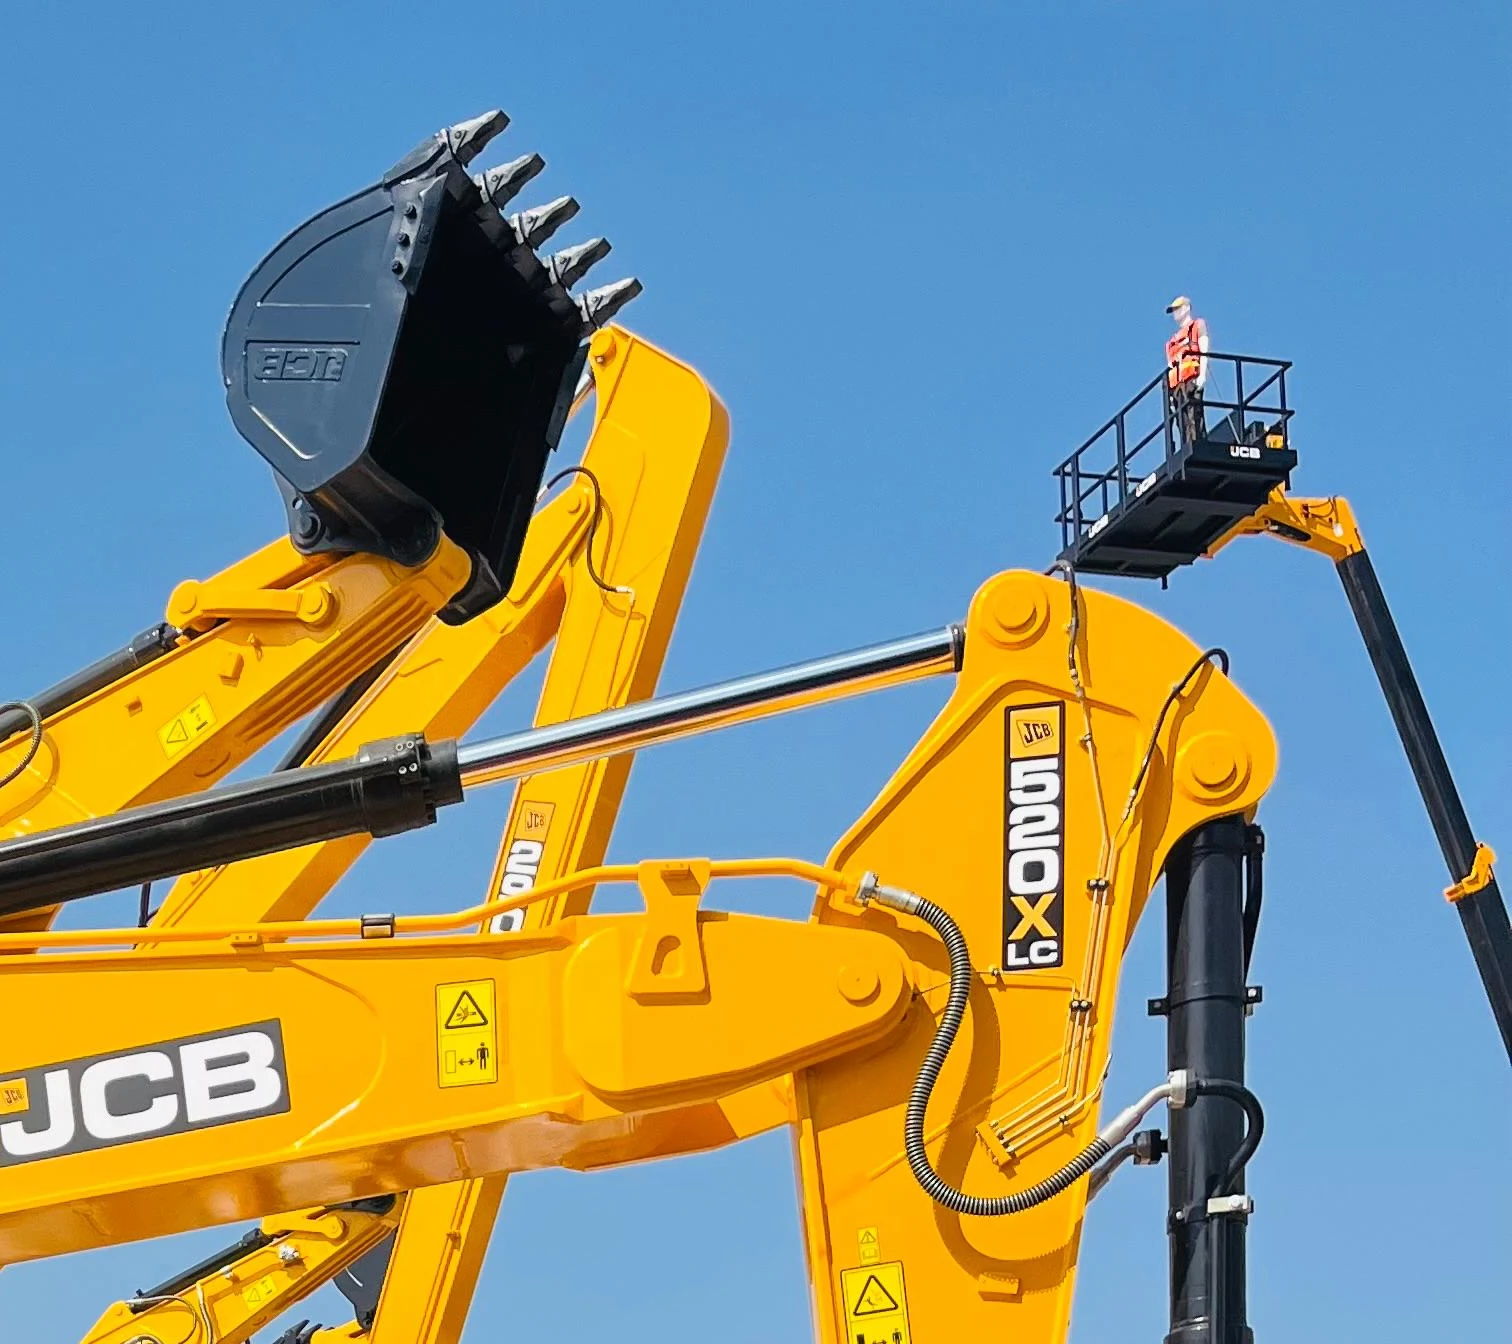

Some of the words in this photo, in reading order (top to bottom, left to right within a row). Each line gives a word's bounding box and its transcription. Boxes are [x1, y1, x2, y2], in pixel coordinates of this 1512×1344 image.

[1023, 722, 1052, 744] JCB
[1007, 939, 1059, 967] LC
[0, 1031, 282, 1156] JCB
